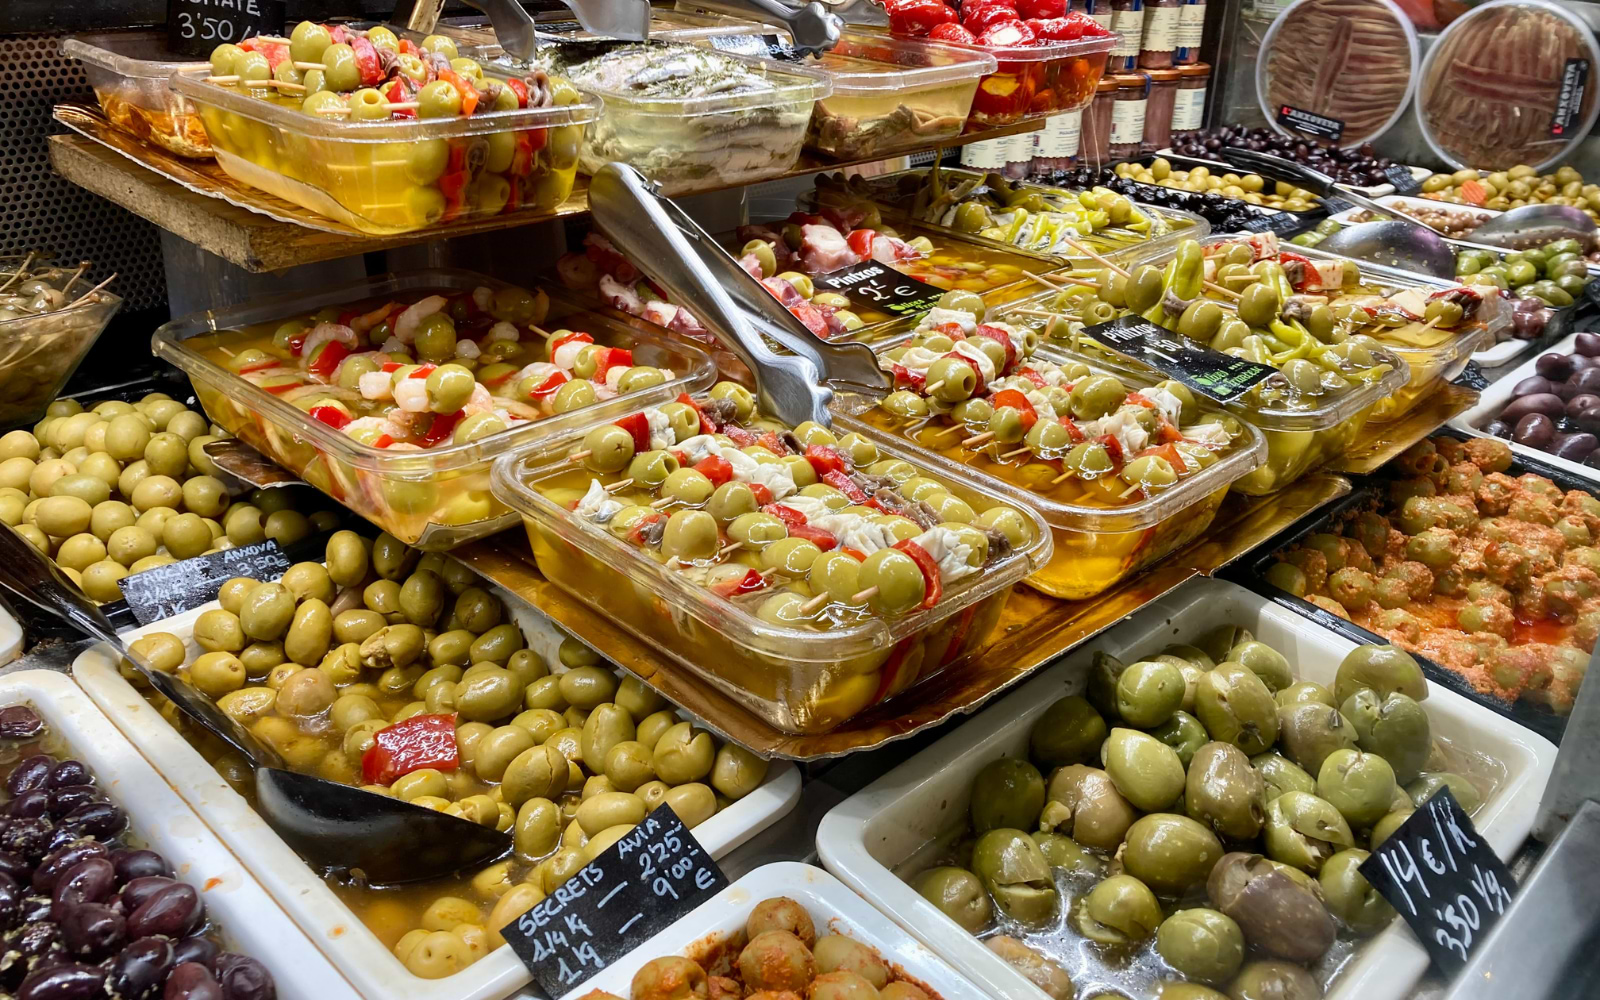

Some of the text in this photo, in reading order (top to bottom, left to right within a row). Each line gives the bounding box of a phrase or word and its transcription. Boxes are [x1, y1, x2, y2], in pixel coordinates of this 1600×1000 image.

[178, 12, 233, 41] 3'50
[1552, 63, 1577, 134] L'ANXOVETA
[826, 266, 884, 288] Pintxos
[894, 285, 917, 296] €
[1101, 324, 1157, 343] Pintxos
[128, 557, 210, 589] FARCIDES
[695, 867, 716, 890] €
[518, 862, 605, 937] SECRETS
[532, 931, 569, 962] 1/4
[557, 957, 582, 985] 1
[572, 941, 605, 968] Kg
